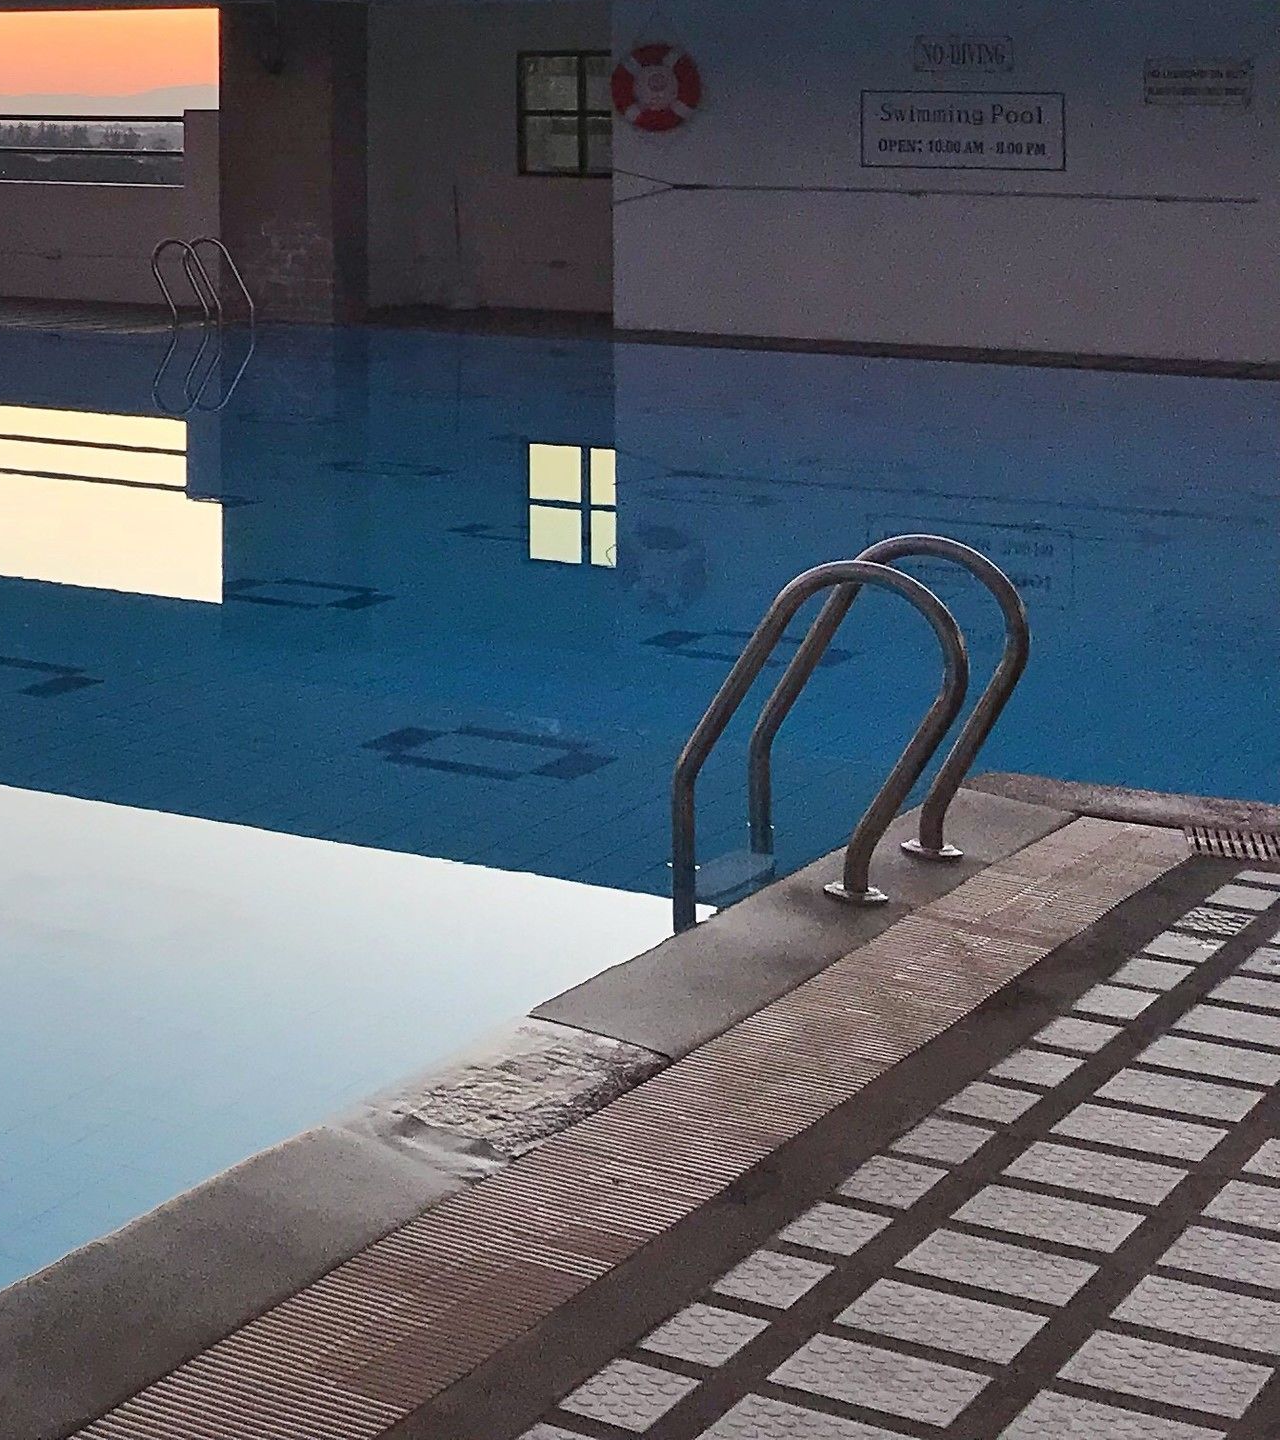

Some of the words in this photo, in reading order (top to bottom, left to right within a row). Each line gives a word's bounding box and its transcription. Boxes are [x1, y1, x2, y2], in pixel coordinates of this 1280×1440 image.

[921, 42, 944, 65] NO
[950, 42, 1006, 65] DIVING
[879, 103, 984, 126] Swimming
[991, 103, 1044, 125] Pool
[963, 141, 984, 155] AM
[1025, 142, 1046, 157] PM
